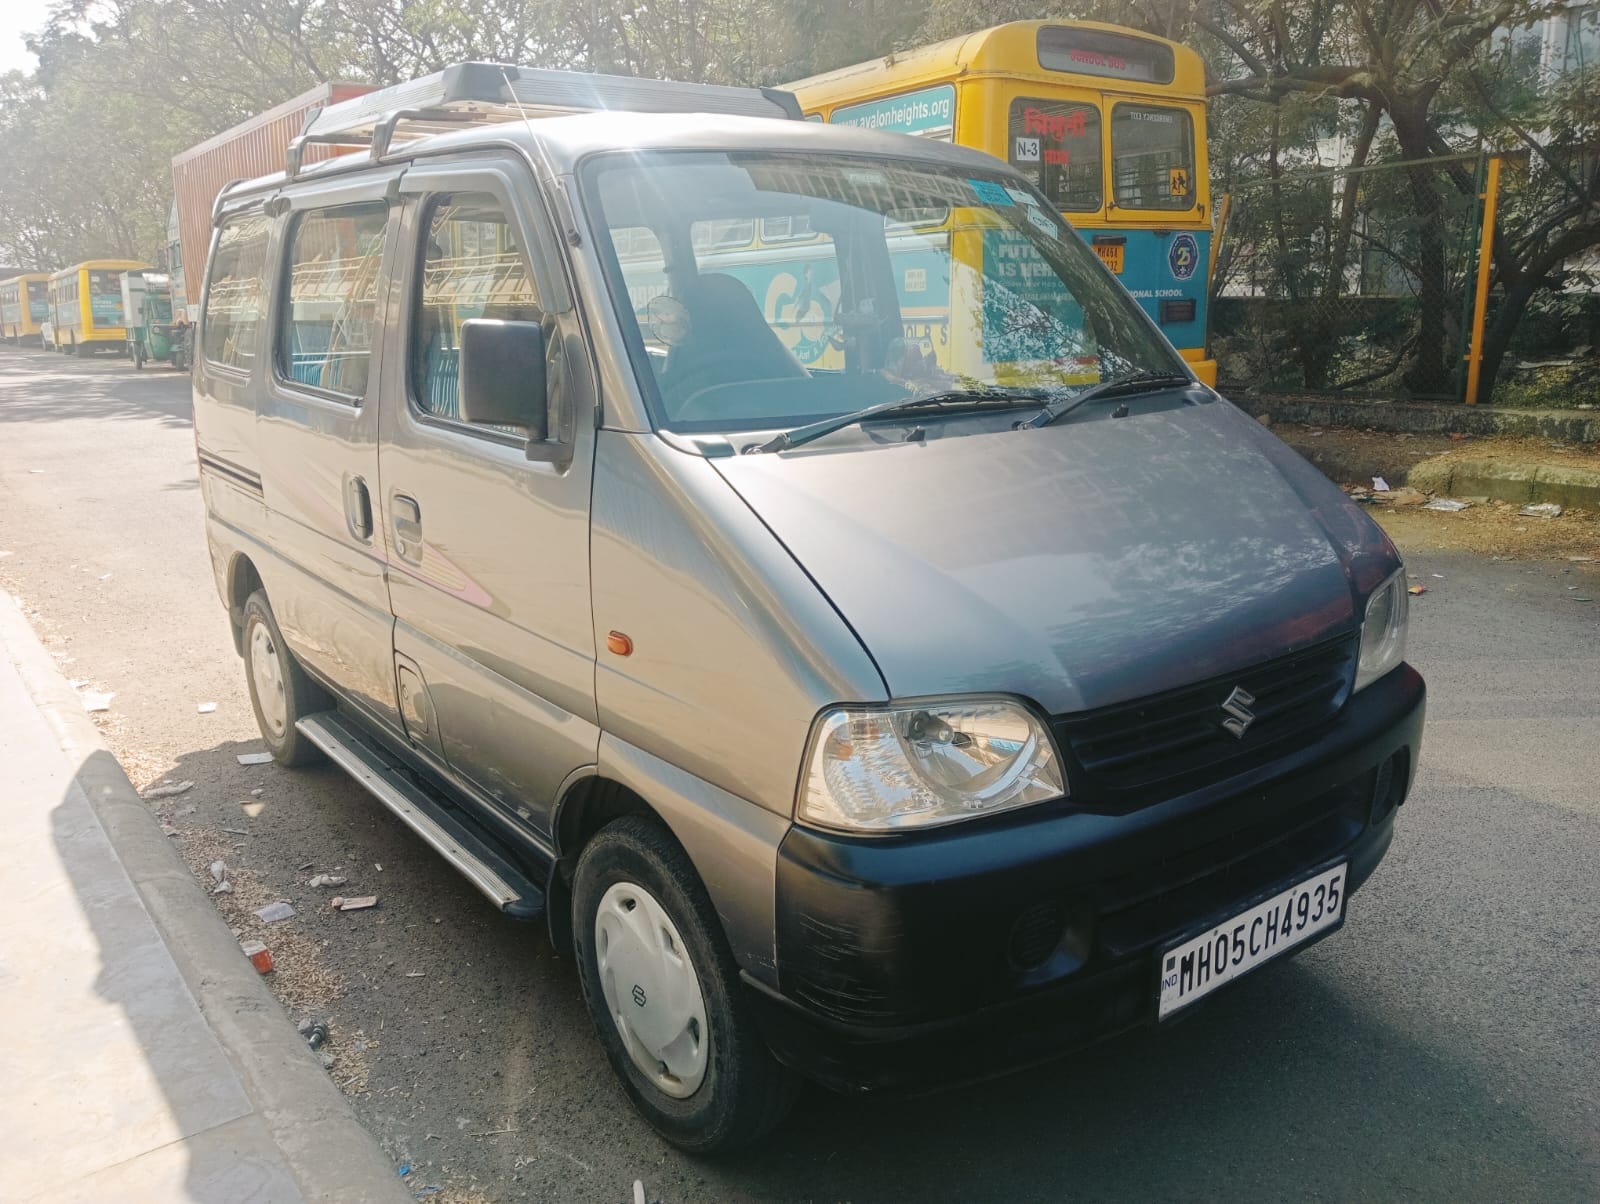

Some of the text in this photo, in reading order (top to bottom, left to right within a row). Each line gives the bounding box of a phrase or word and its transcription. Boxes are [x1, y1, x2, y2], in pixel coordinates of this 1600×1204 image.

[1018, 141, 1038, 157] N-3
[1155, 288, 1183, 298] SCHOOL
[1179, 875, 1341, 997] MH05CH4935
[1162, 973, 1178, 992] IND
